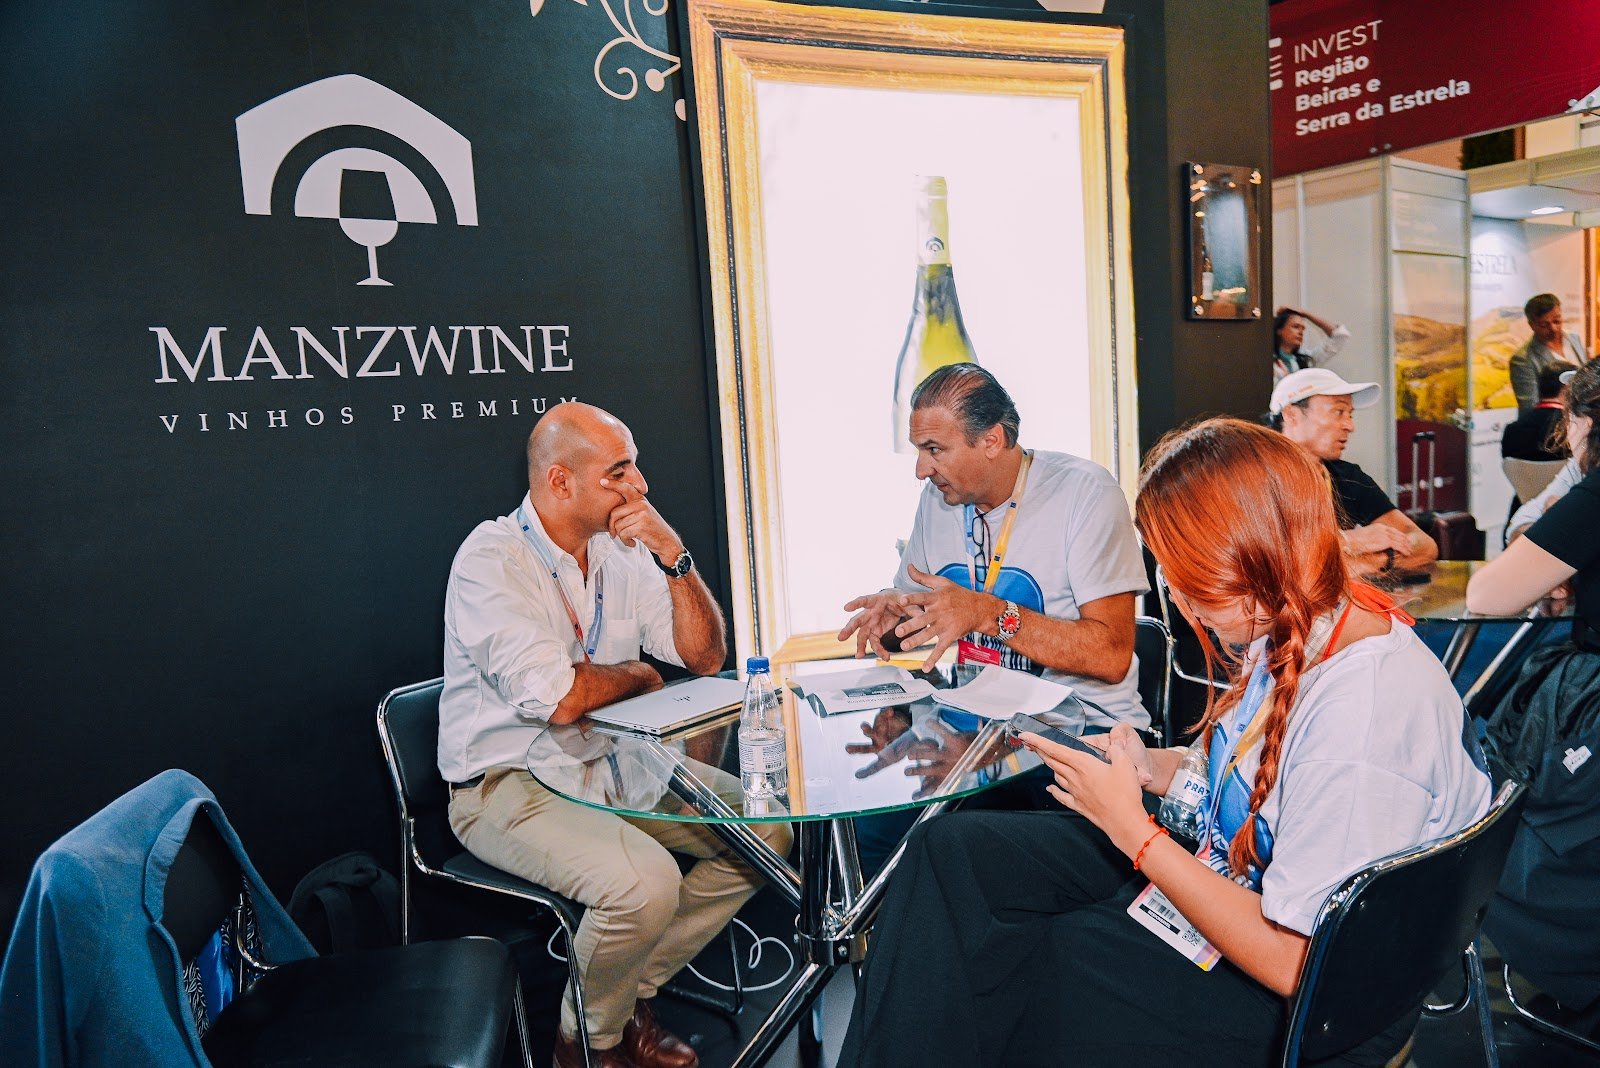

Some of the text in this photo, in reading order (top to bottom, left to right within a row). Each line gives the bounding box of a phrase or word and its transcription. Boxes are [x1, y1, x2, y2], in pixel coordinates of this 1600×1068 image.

[1294, 20, 1383, 63] INVEST
[1295, 55, 1370, 88] Região
[1295, 78, 1381, 111] Beiras e
[1295, 79, 1471, 136] Serra da Estrela
[148, 325, 574, 384] MANZWINE
[159, 407, 355, 433] VINHOS
